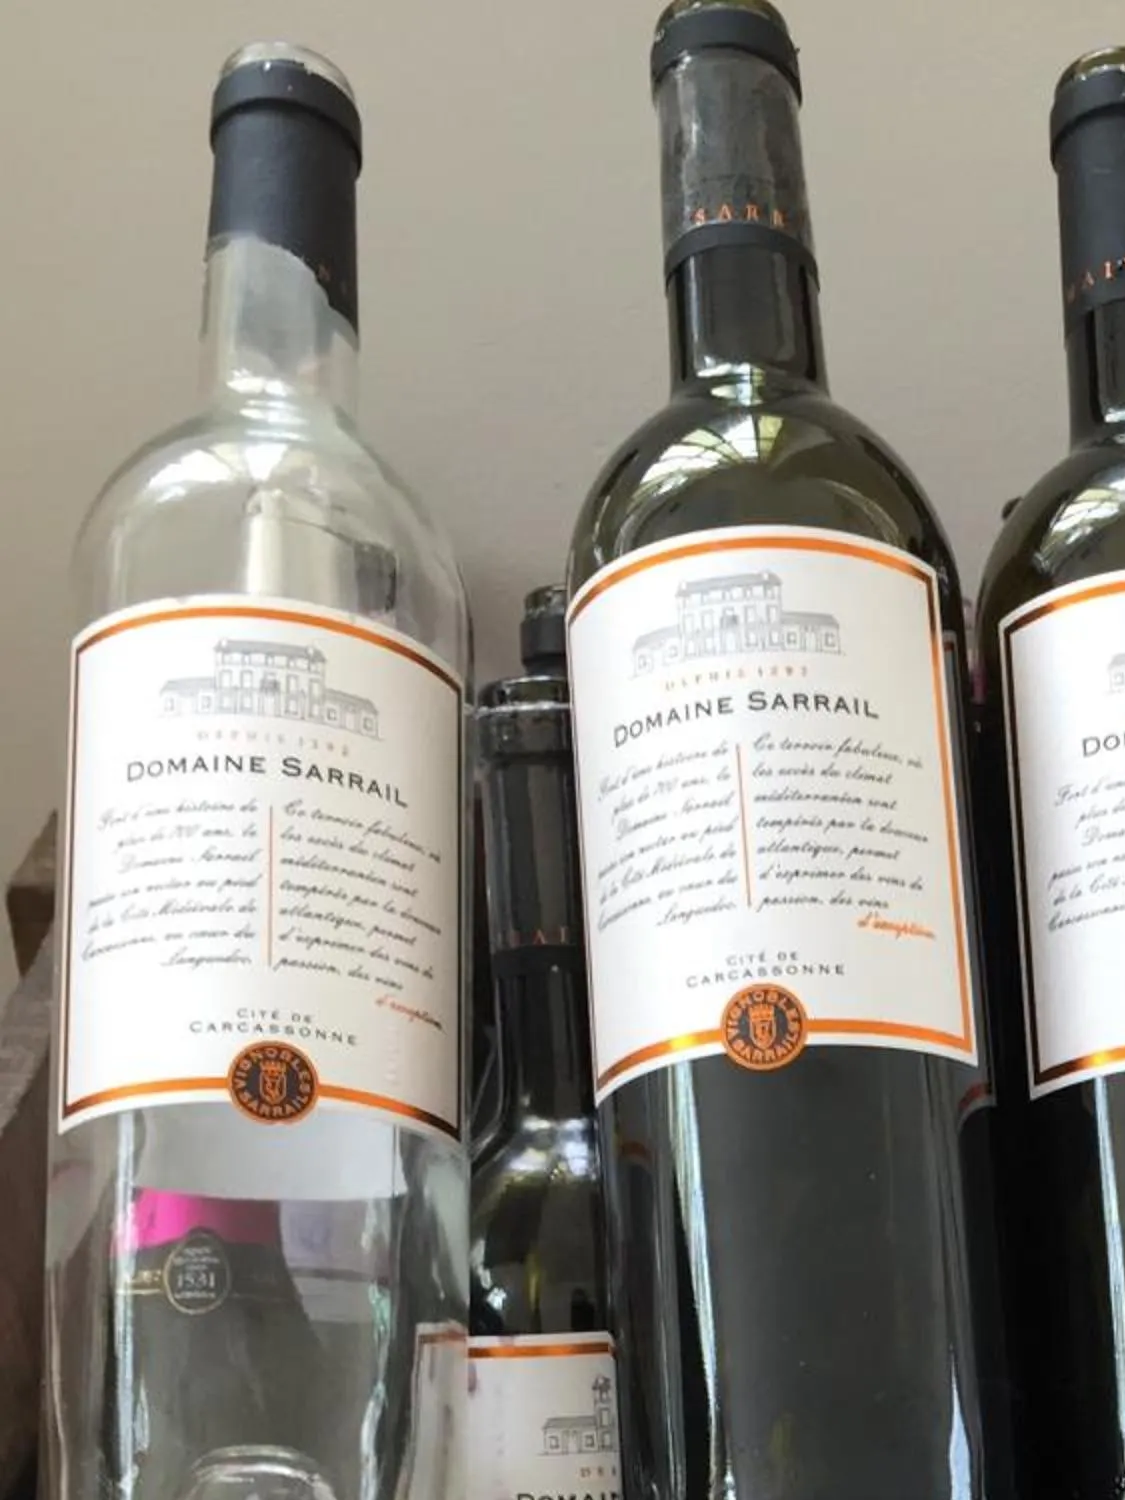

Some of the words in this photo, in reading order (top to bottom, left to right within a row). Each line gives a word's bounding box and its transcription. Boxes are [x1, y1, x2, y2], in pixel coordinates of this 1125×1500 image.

[691, 202, 786, 226] SARR
[612, 695, 735, 748] DOMAINE
[746, 690, 881, 720] SARRAIL
[127, 755, 266, 783] DOMAINE
[281, 756, 409, 809] SARRAIL
[725, 950, 768, 967] CITÉ
[777, 951, 800, 963] DE
[685, 963, 847, 989] CARCASSONNE
[236, 1007, 281, 1020] CITÉ
[291, 1012, 314, 1025] DE
[189, 1021, 359, 1047] CARCASSONNE
